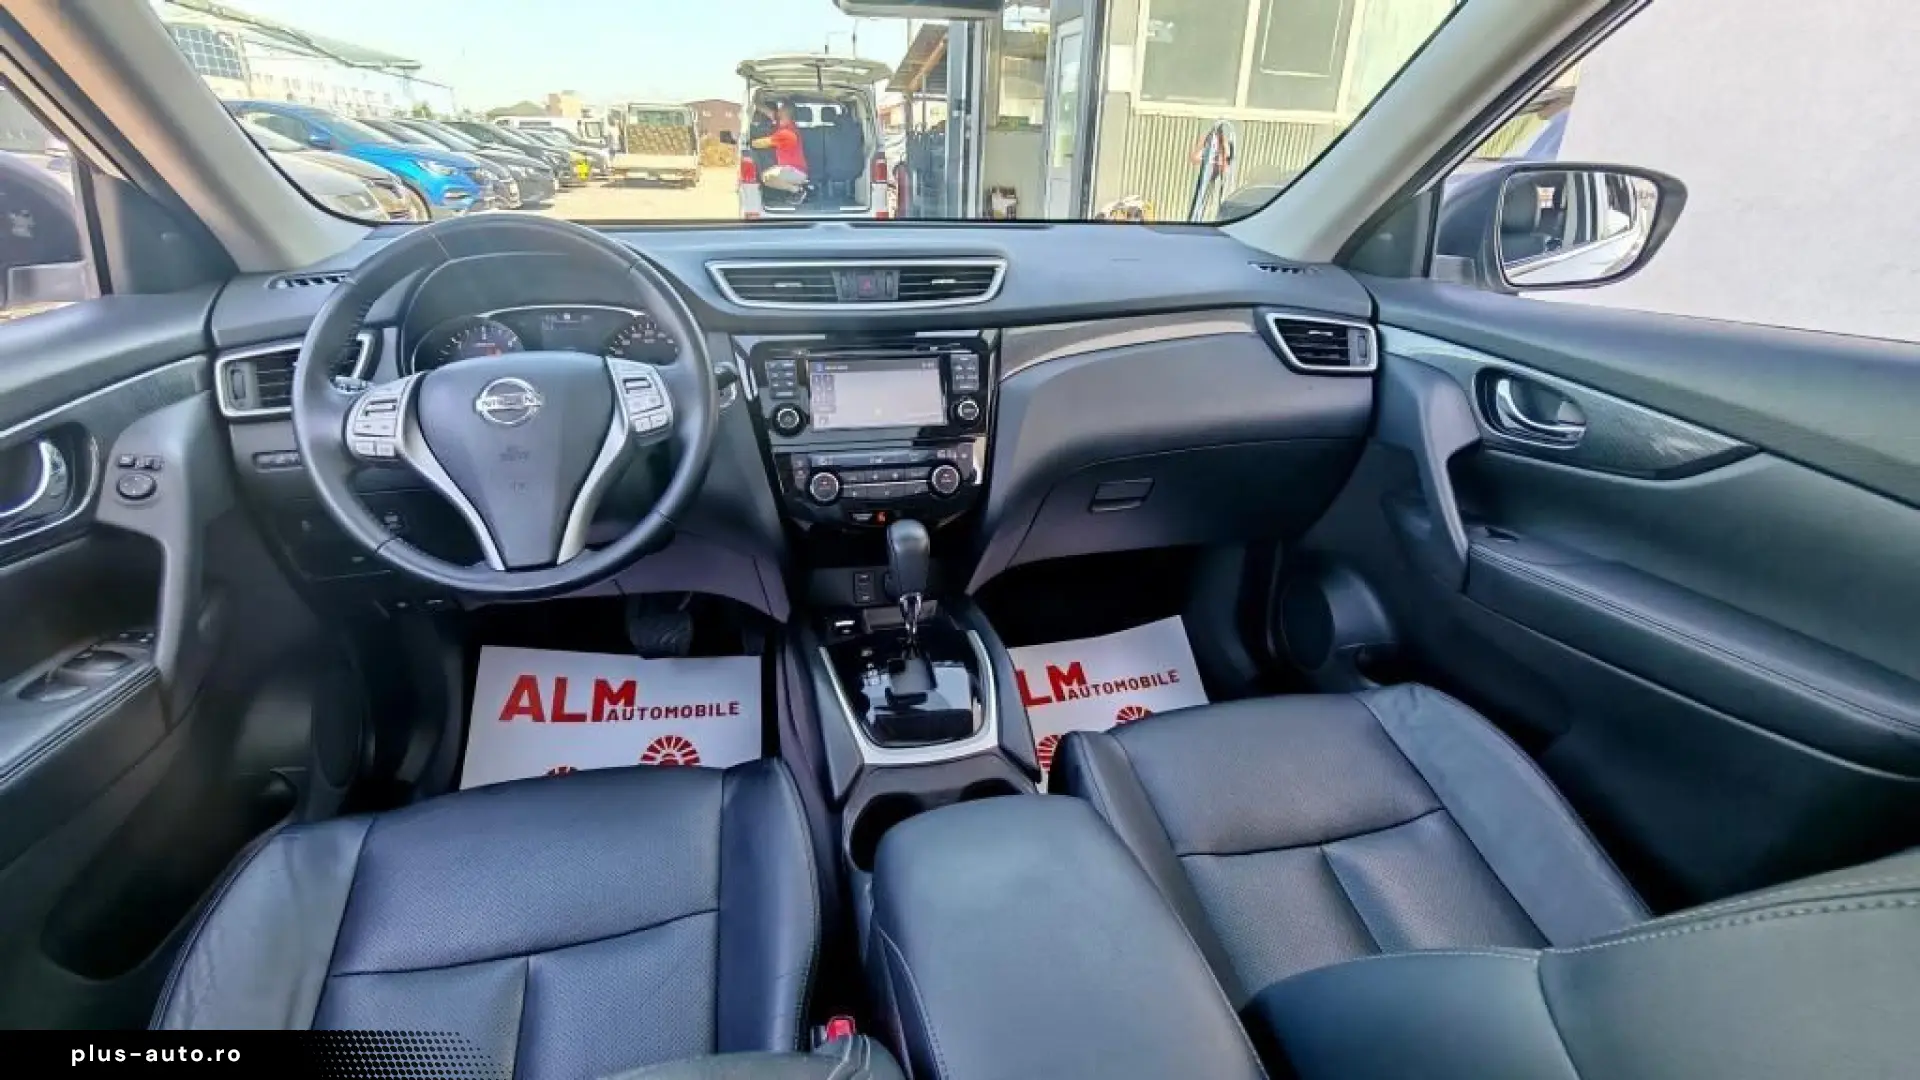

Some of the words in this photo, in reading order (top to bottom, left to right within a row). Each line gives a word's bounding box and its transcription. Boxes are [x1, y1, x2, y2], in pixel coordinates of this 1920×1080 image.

[499, 674, 637, 723] ALM
[606, 700, 740, 721] AUTOMOBILE
[1016, 662, 1087, 707] LM
[1068, 669, 1180, 701] AUTOMOBILE
